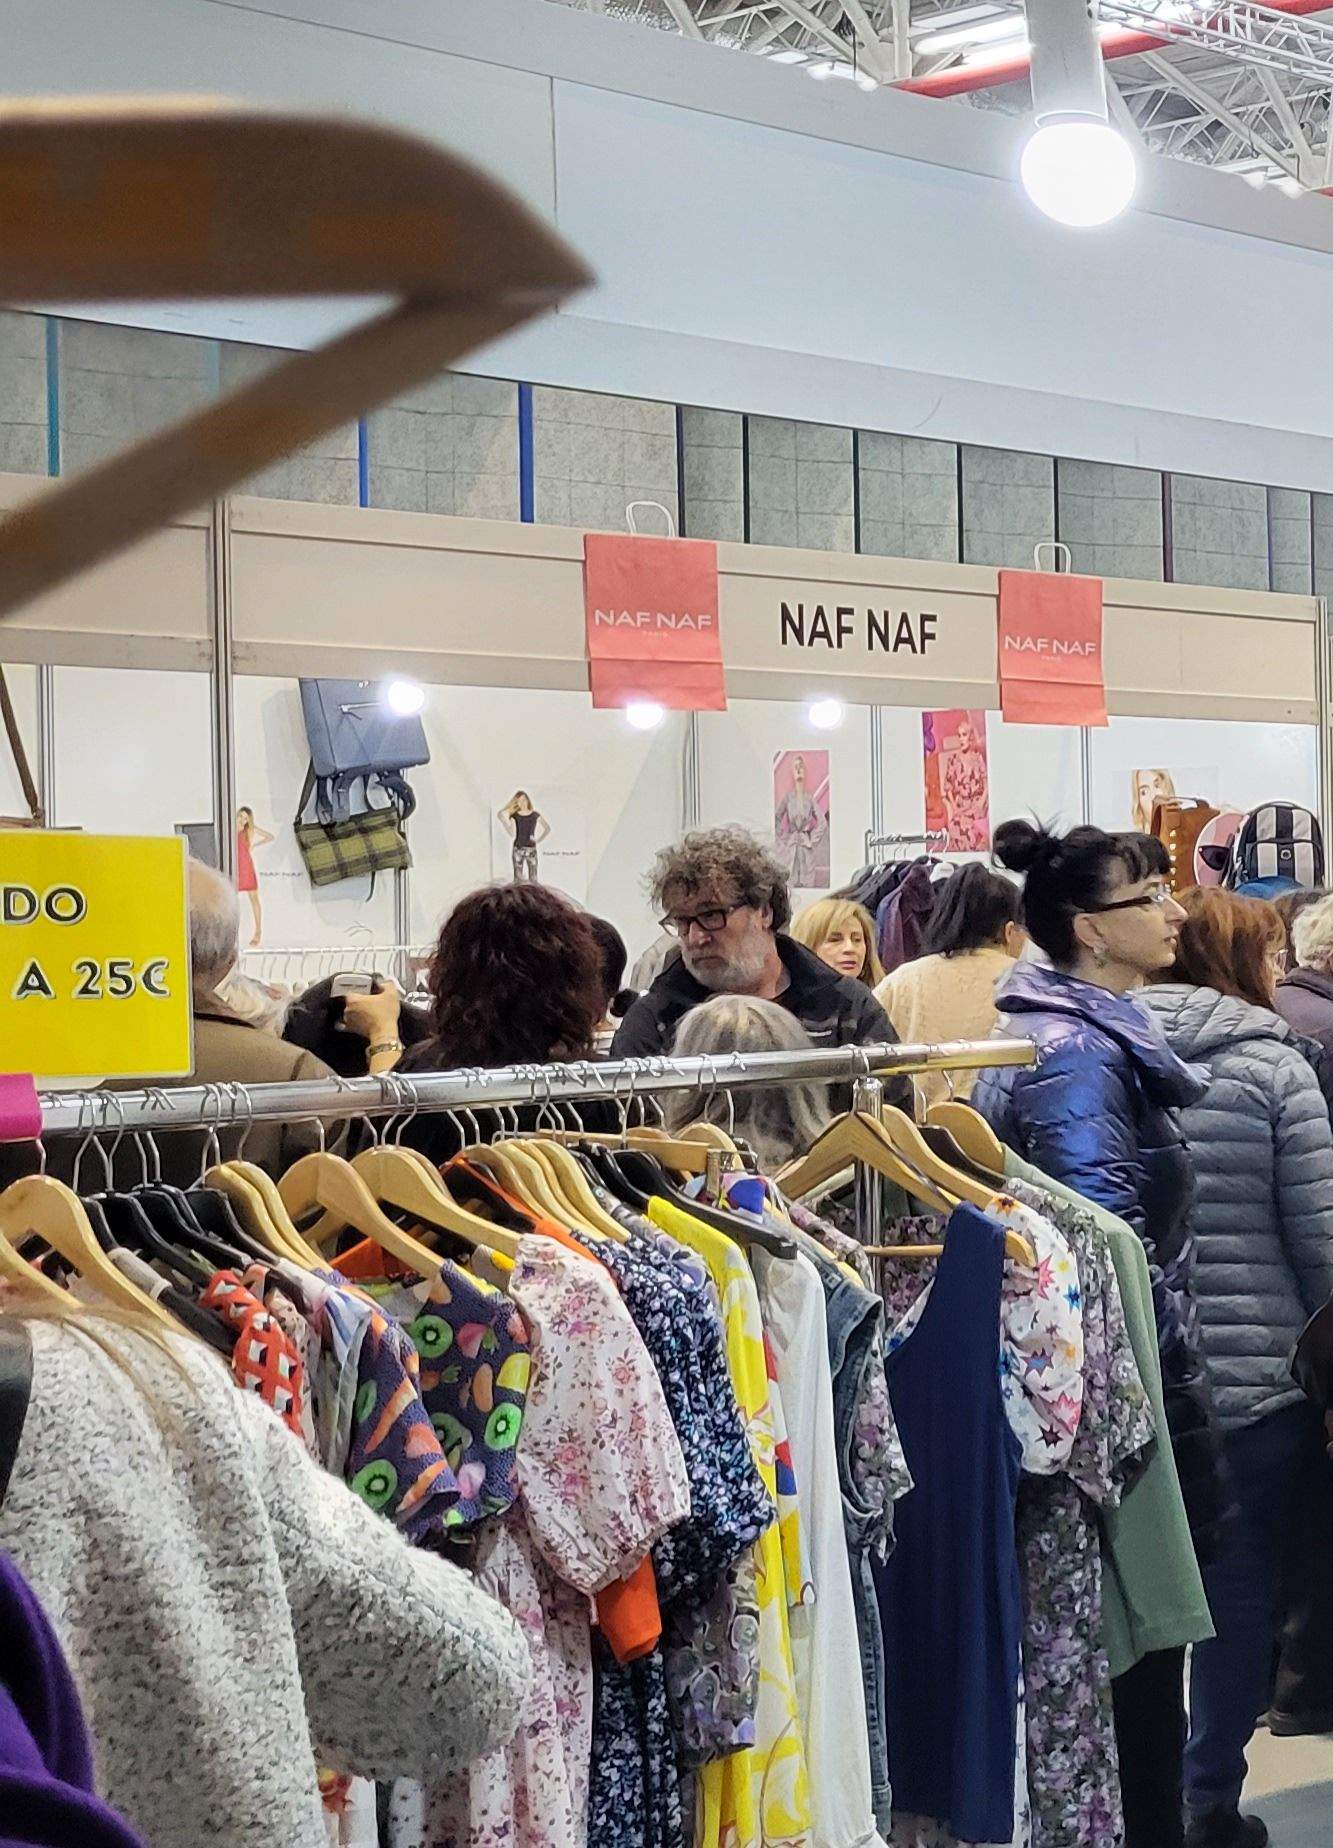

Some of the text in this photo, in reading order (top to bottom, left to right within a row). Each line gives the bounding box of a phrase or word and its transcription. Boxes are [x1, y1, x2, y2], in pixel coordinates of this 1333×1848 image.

[594, 608, 712, 630] NAF NAF
[781, 602, 937, 655] NAF NAF
[1004, 634, 1097, 657] NAF NAF
[17, 960, 170, 996] A 25€
